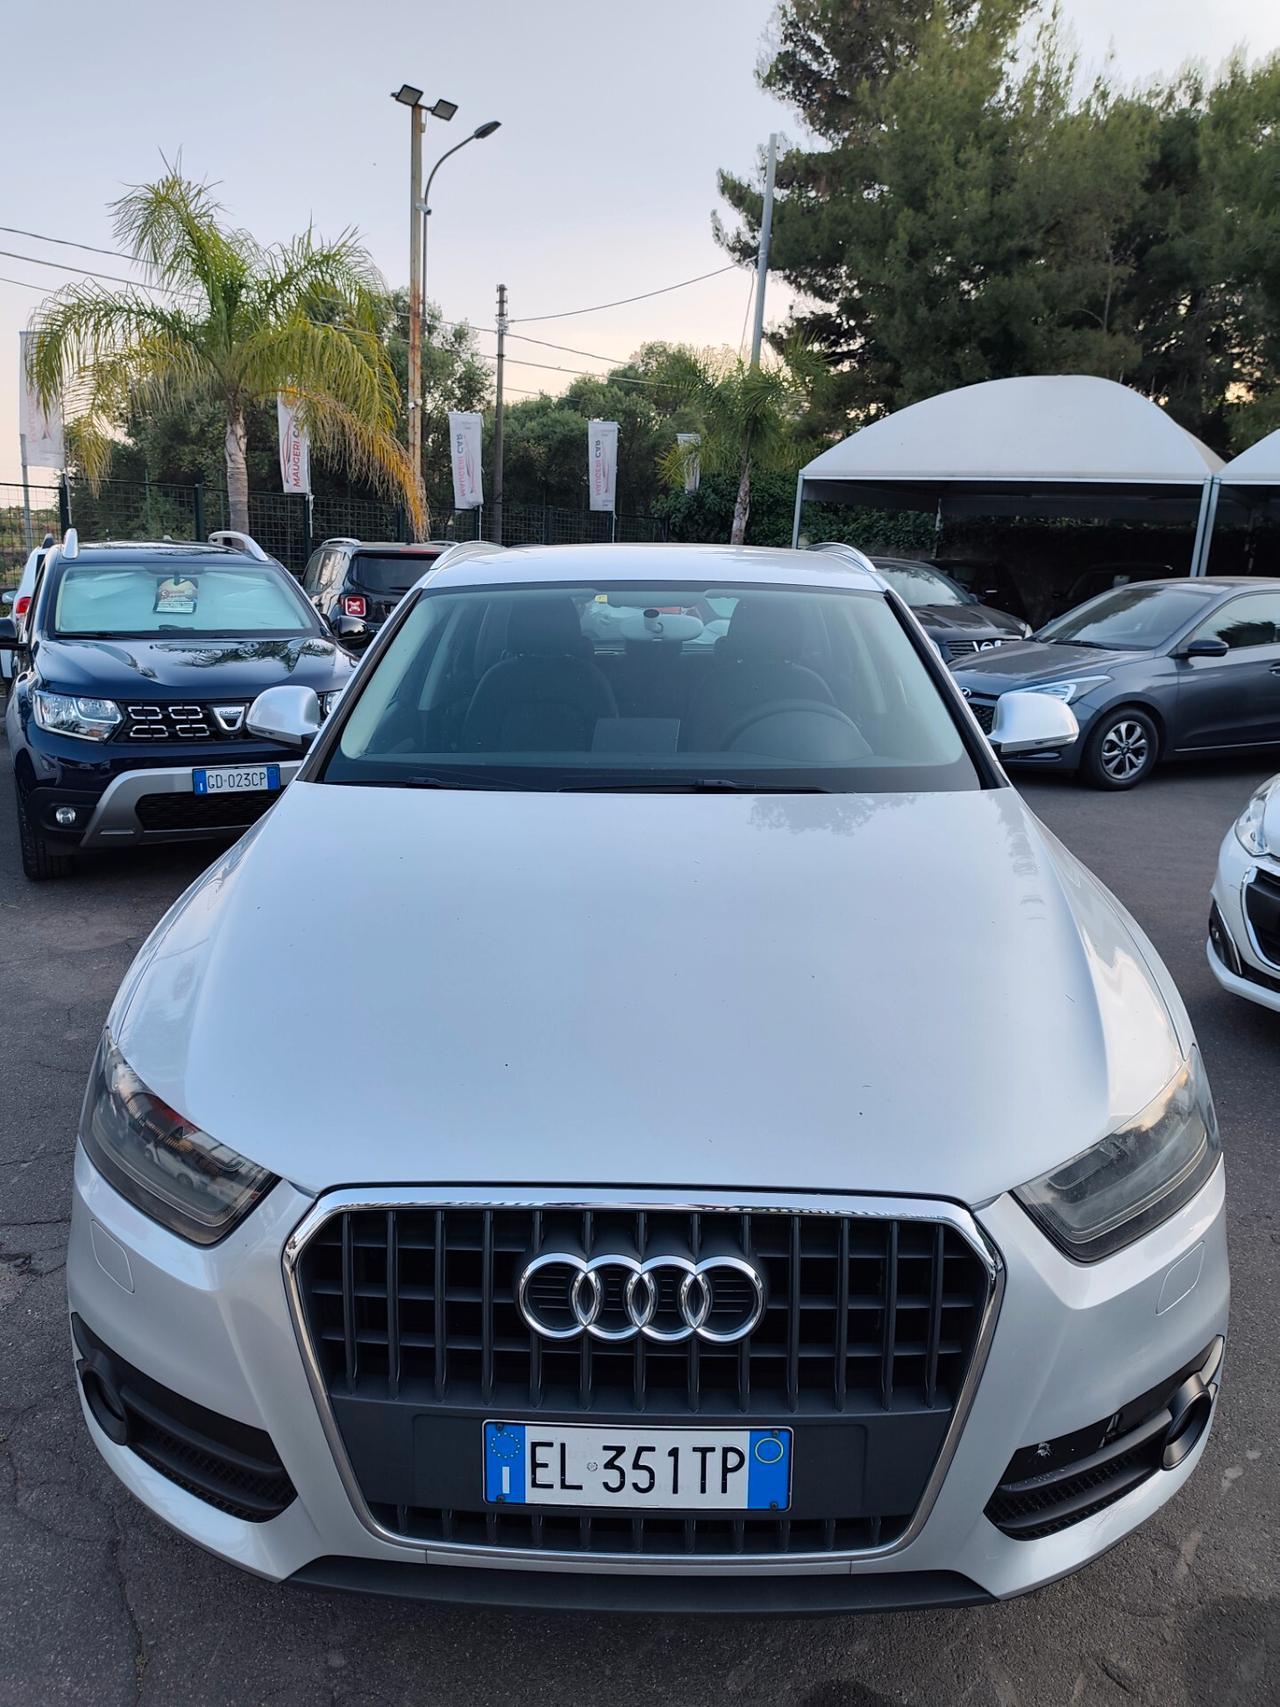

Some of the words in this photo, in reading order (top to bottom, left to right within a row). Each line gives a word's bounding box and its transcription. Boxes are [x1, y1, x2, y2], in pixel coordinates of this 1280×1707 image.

[292, 440, 301, 488] MAUGERI
[207, 774, 223, 789] GD
[228, 772, 267, 788] 023CP
[502, 1466, 510, 1494] I
[530, 1441, 583, 1490] EL
[602, 1445, 745, 1494] 351TP
